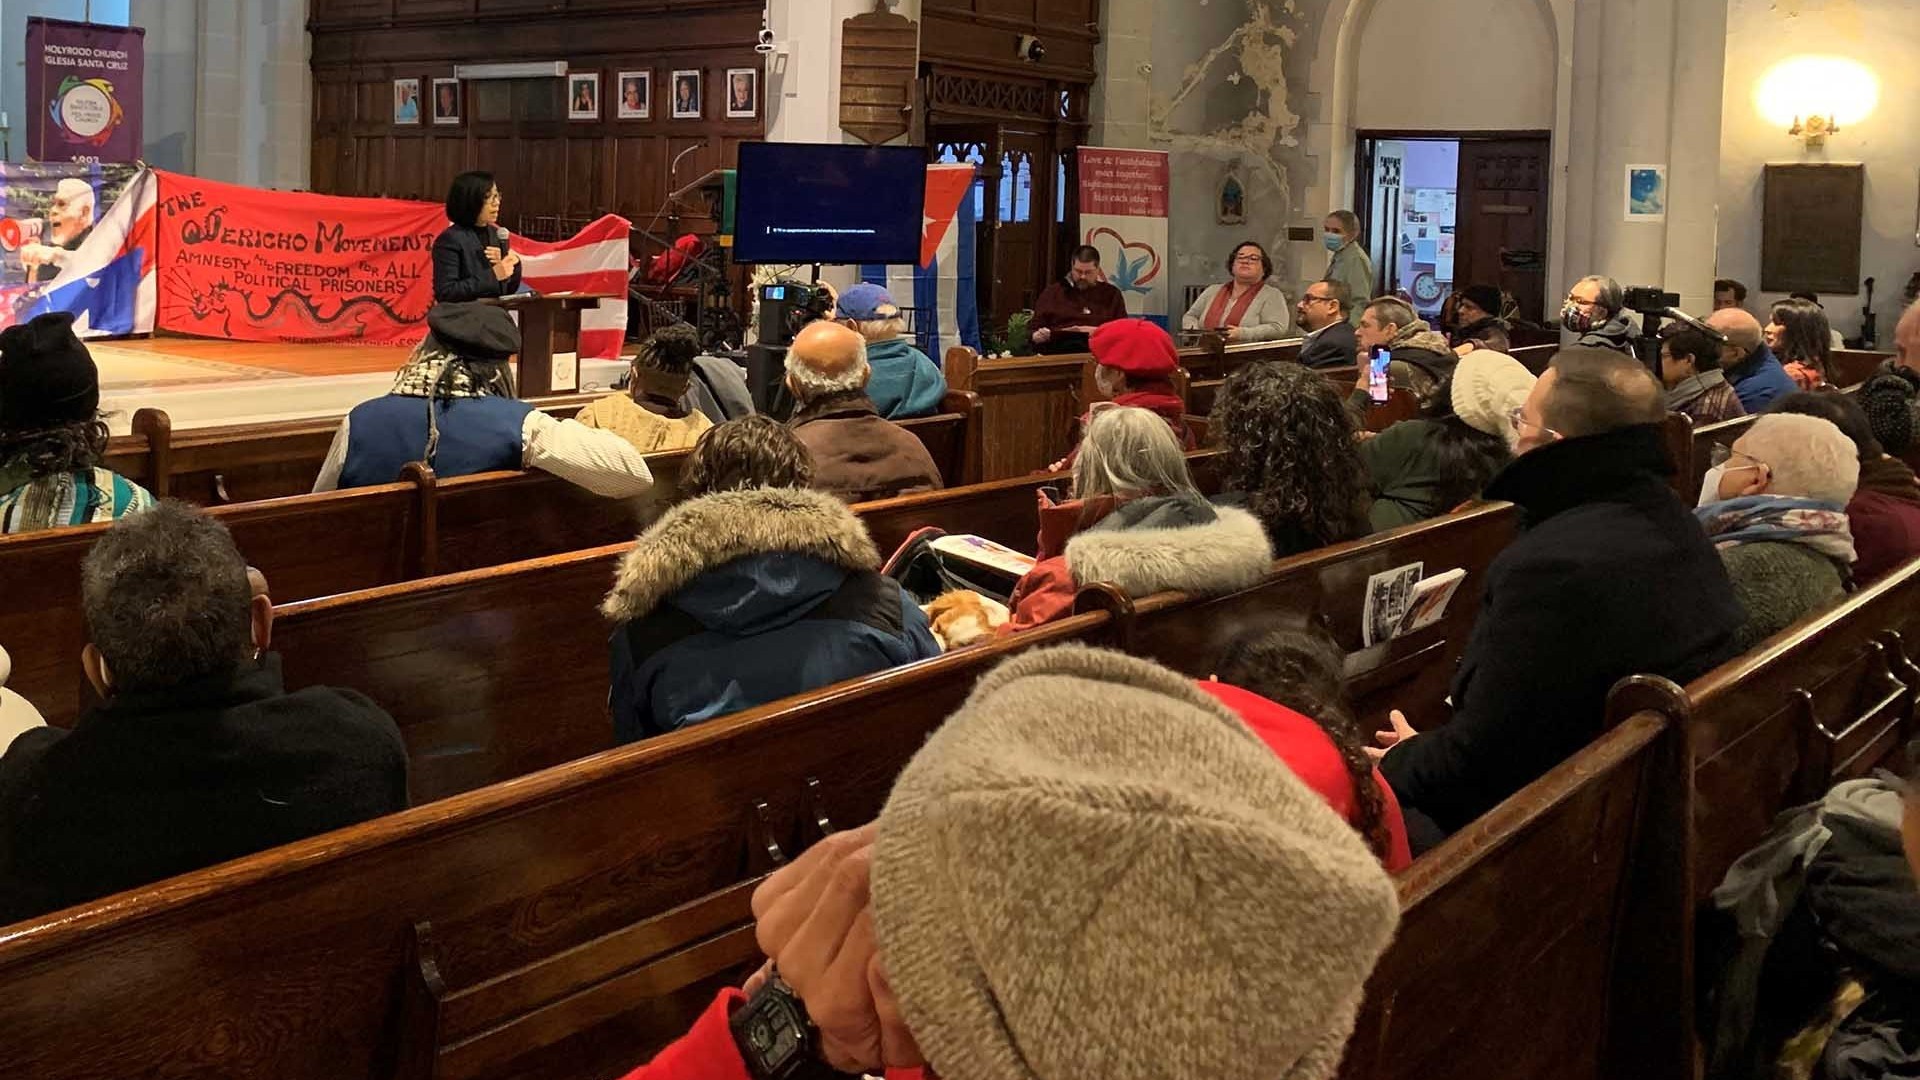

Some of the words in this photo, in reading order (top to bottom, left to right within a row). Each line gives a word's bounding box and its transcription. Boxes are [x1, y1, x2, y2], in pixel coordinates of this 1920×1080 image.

[44, 45, 92, 56] HOLYROOD
[93, 49, 128, 60] CHURCH
[44, 56, 75, 66] IGLESIA
[77, 59, 105, 69] SANTA
[106, 61, 128, 71] CRUZ
[160, 191, 206, 217] THE
[181, 205, 308, 252] JERICHO
[314, 221, 434, 254] MOVEMENT
[175, 249, 251, 271] AMNESTY
[275, 261, 350, 278] FREEDOM
[358, 261, 380, 277] FOR
[383, 261, 421, 279] ALL
[233, 270, 312, 292] POLITICAL
[320, 278, 408, 296] PRISONERS
